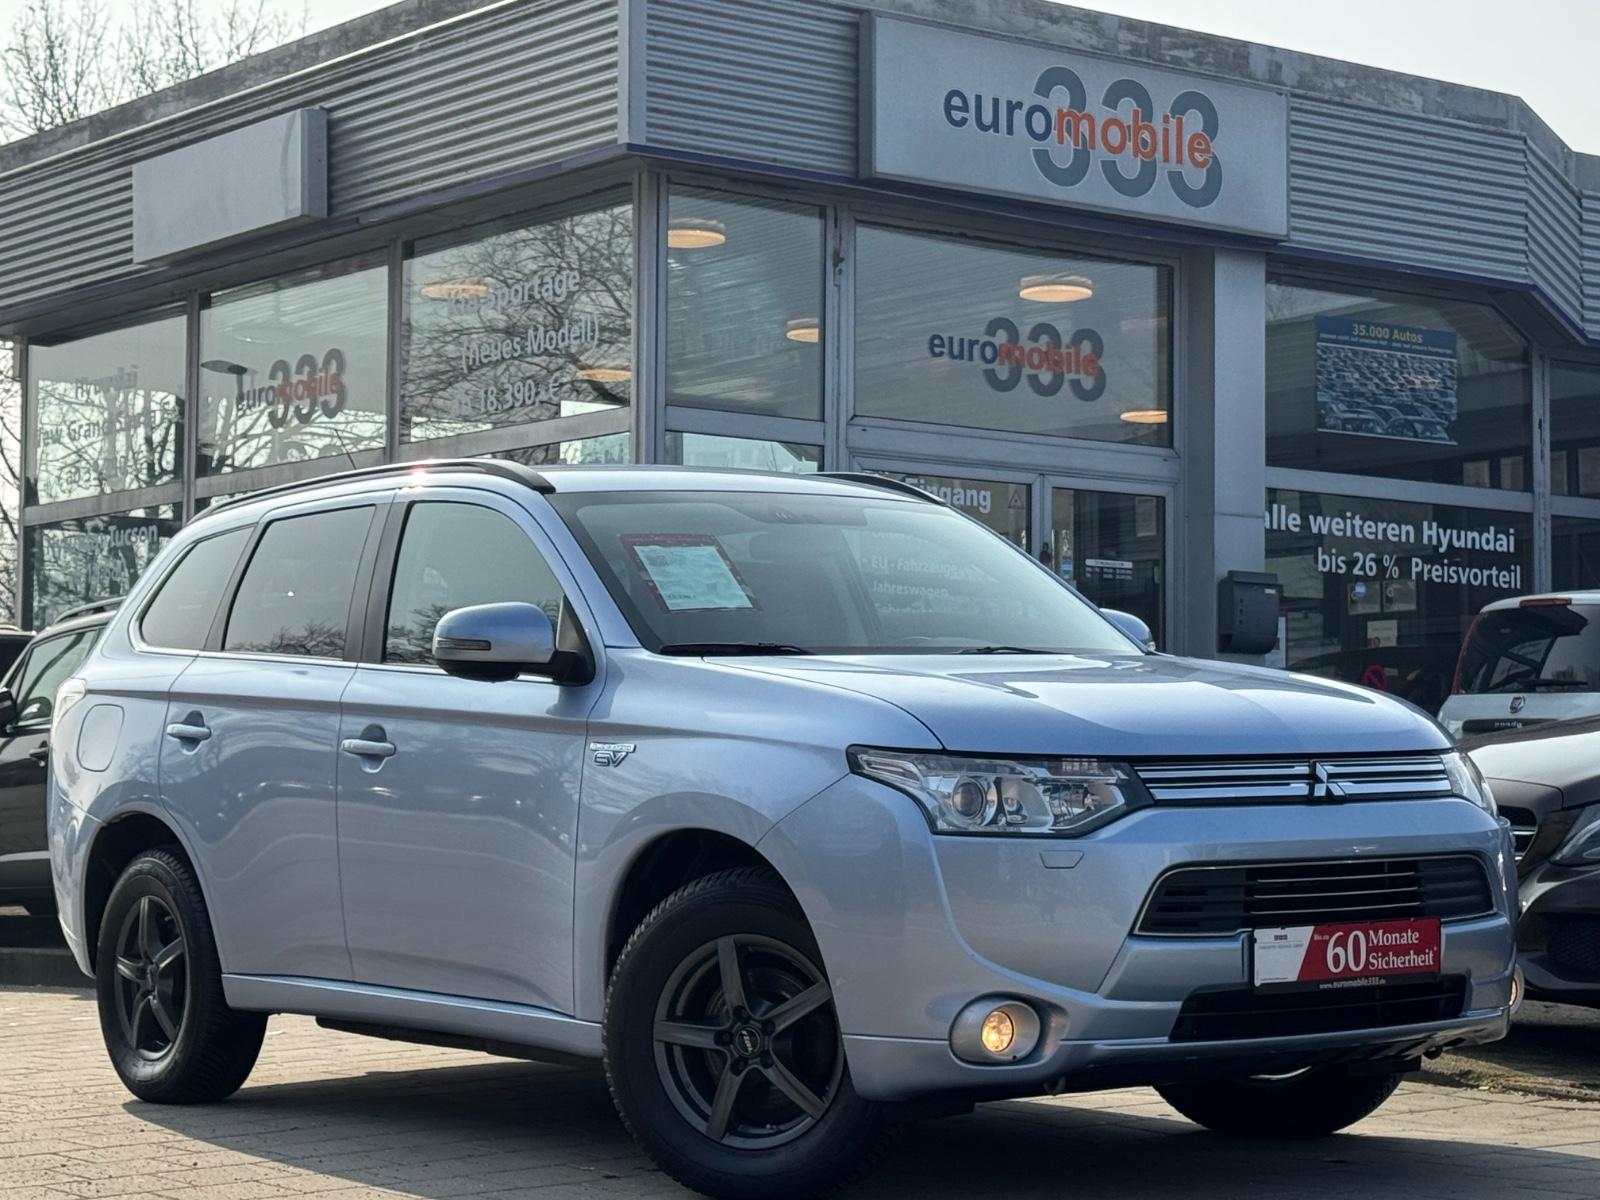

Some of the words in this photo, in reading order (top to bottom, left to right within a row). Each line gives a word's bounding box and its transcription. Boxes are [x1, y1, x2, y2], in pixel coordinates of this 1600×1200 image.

[943, 88, 1212, 168] euromobile
[1031, 65, 1223, 208] 333
[461, 335, 521, 374] (neues
[526, 312, 599, 355] Modell)
[928, 332, 1100, 377] euromobile
[1352, 323, 1390, 340] 35.000
[1392, 328, 1424, 344] Autos
[982, 317, 1107, 401] 333
[108, 524, 158, 548] Tucson
[1308, 511, 1415, 543] weiteren
[1422, 520, 1515, 553] Hyundai
[1317, 546, 1347, 574] bis
[1352, 551, 1377, 577] 26
[1383, 554, 1399, 579] %
[1411, 557, 1521, 589] Preisvorteil
[1326, 930, 1366, 974] 60
[1368, 929, 1420, 947] Monate
